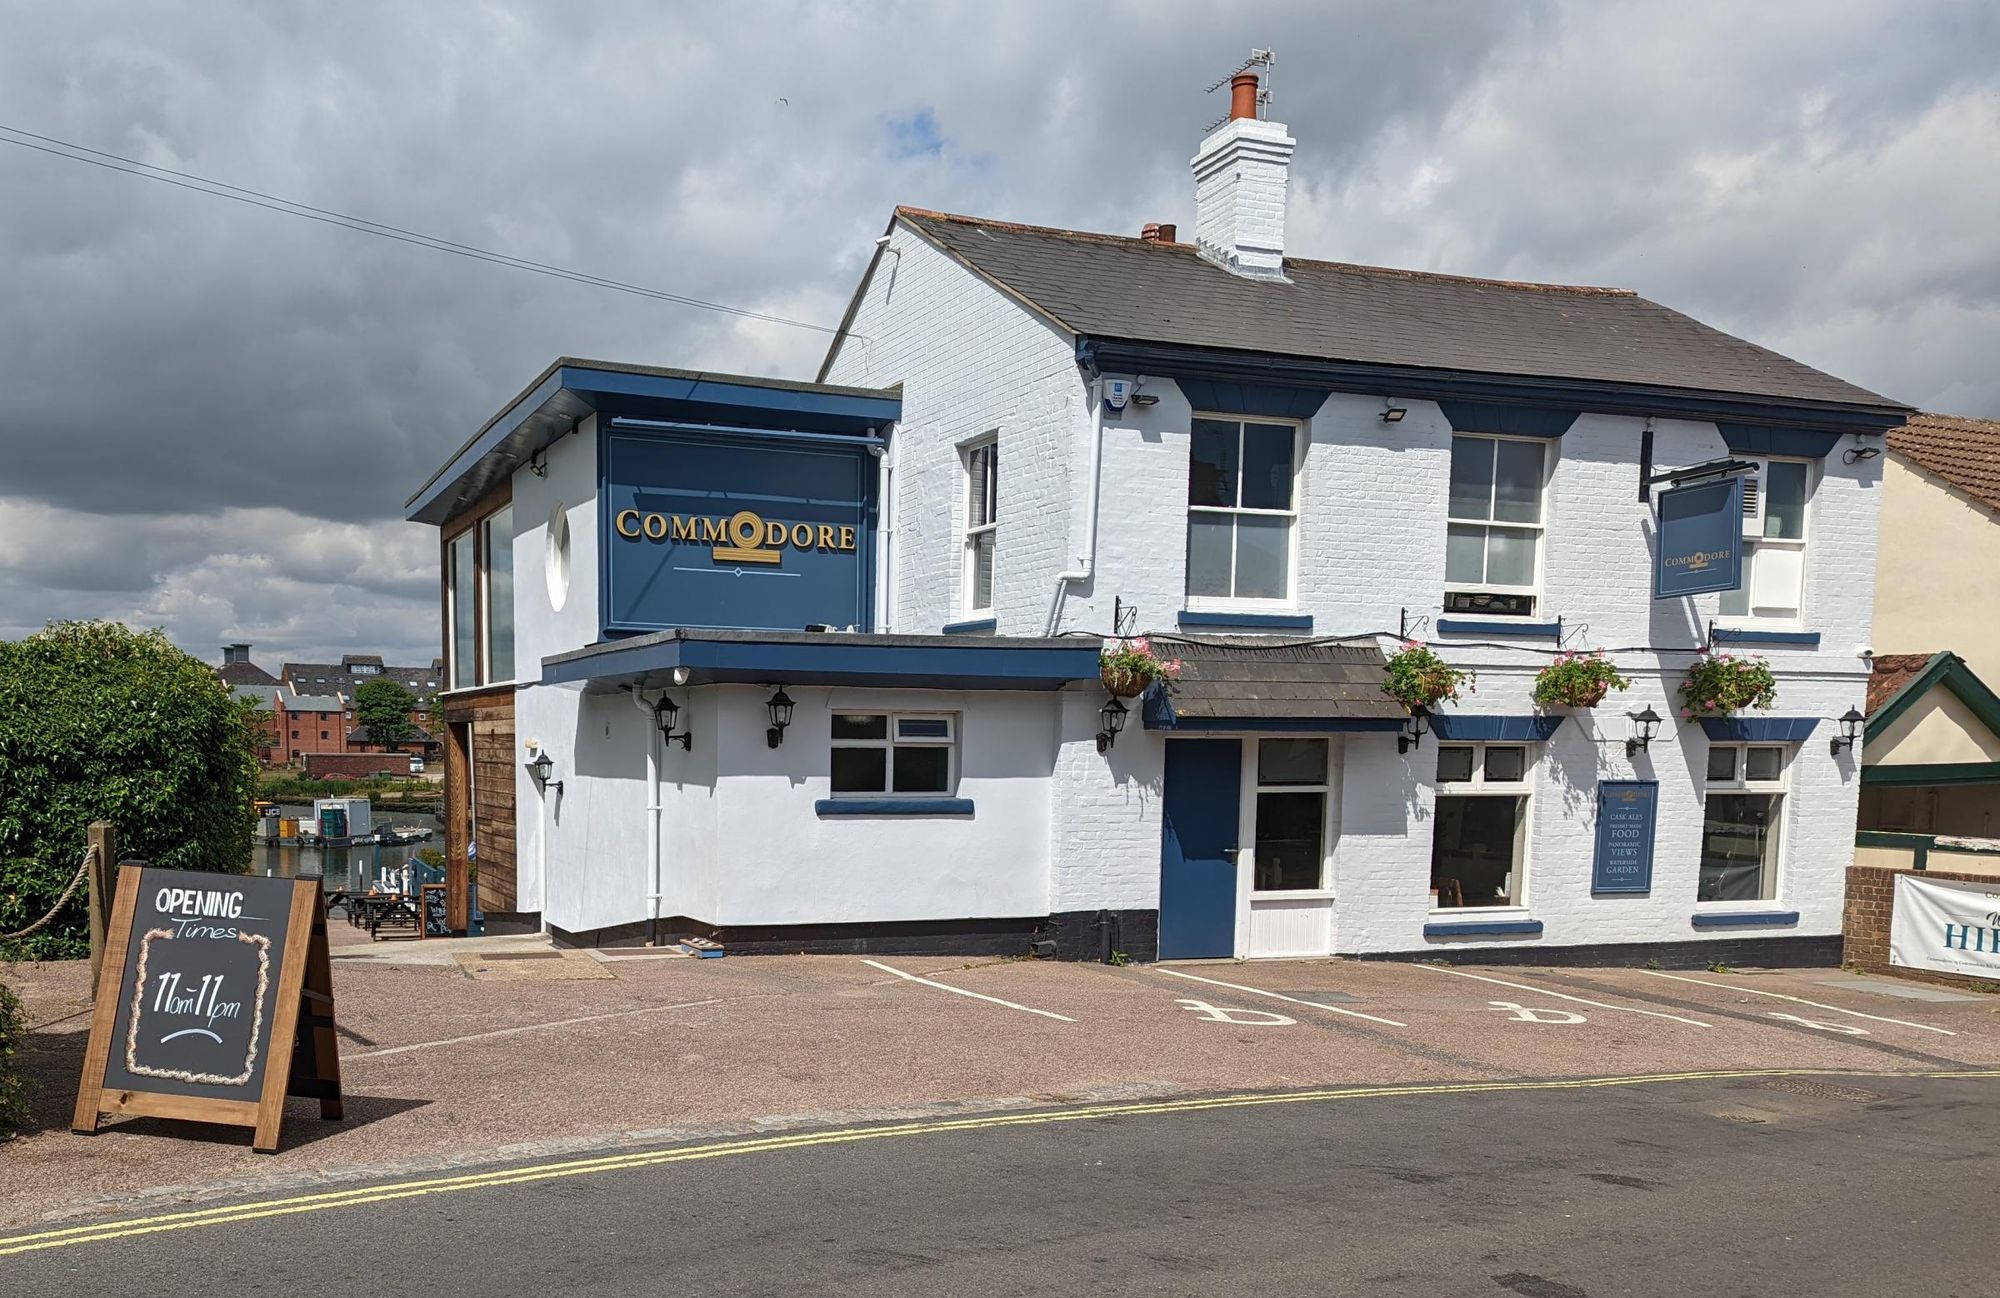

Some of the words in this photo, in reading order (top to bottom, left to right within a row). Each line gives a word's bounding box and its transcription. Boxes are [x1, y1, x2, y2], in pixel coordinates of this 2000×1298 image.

[616, 510, 856, 550] COMMODORE
[1664, 551, 1731, 567] COMMODORE
[1611, 829, 1639, 838] FOOD
[1611, 848, 1637, 856] VIEWS
[1606, 865, 1639, 873] GARDEN
[155, 887, 244, 919] OPENING
[171, 917, 237, 939] Times
